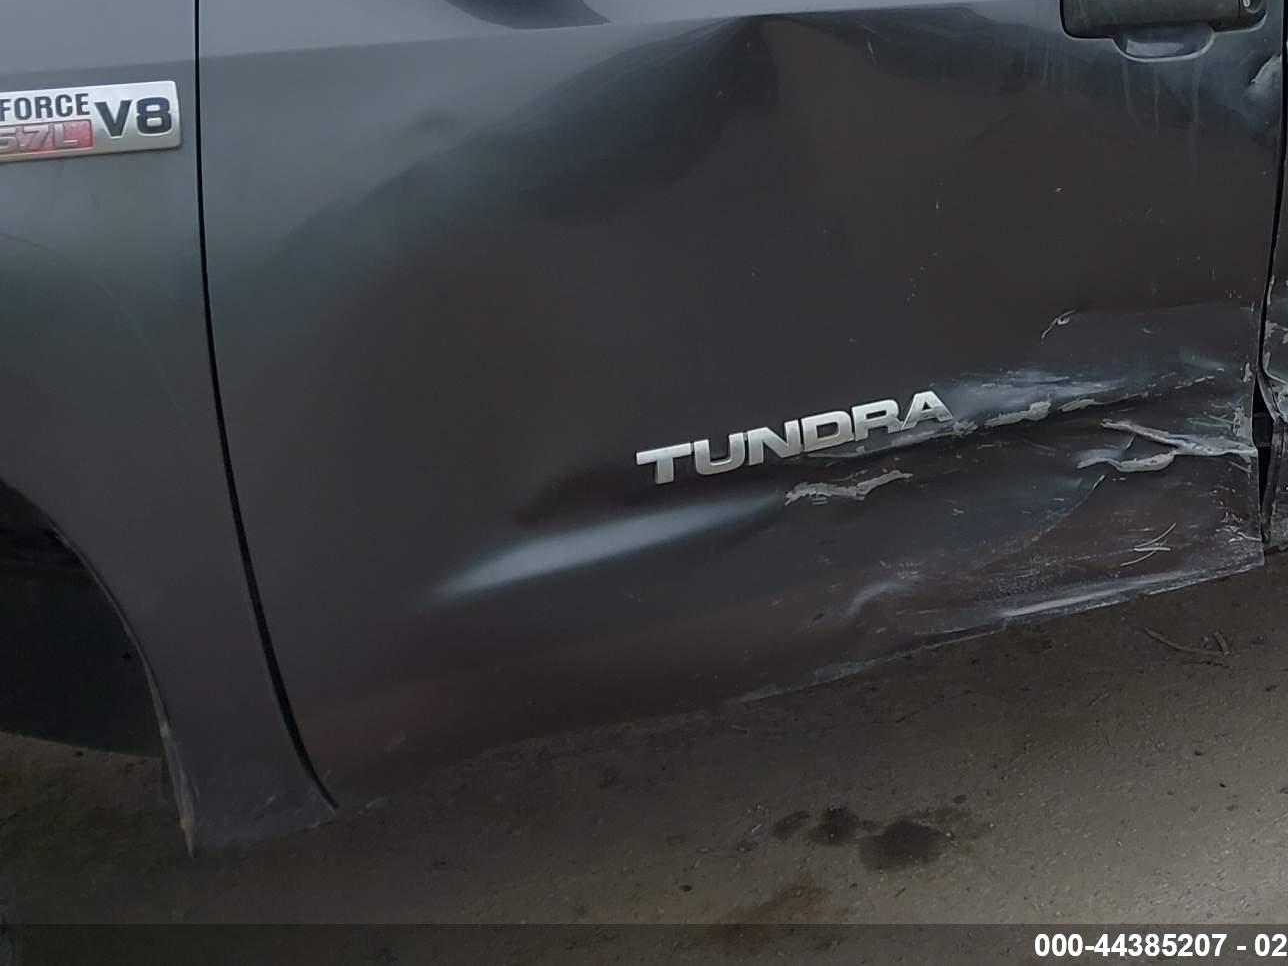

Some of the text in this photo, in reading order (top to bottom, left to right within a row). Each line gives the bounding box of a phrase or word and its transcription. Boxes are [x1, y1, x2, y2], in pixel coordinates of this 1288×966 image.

[0, 93, 173, 139] FORCE V8
[636, 389, 954, 485] TUNDRA
